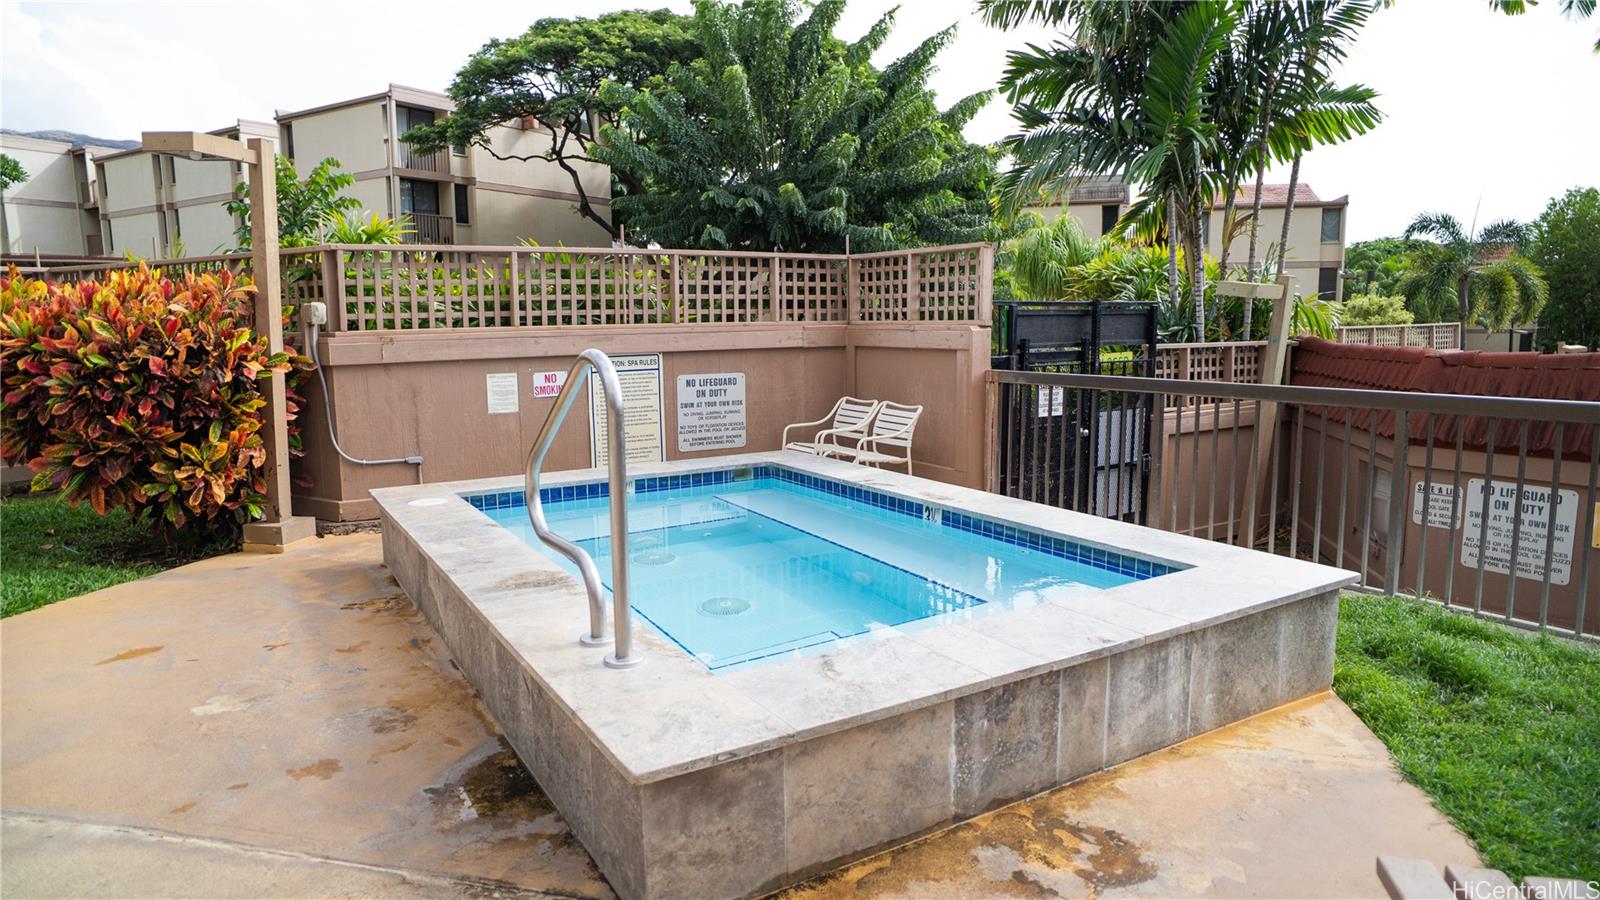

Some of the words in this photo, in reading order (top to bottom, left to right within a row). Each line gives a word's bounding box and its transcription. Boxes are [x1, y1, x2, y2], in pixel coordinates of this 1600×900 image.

[640, 358, 658, 366] RULES
[544, 373, 557, 383] NO
[685, 378, 697, 388] NO
[698, 377, 738, 388] LIFEGUARD
[534, 384, 564, 396] SMOKIN
[696, 389, 706, 398] ON
[708, 388, 728, 398] DUTY
[1438, 486, 1443, 494] A
[1500, 487, 1563, 505] LIFGUARD
[1494, 499, 1509, 511] ON
[1519, 502, 1544, 516] UTY
[1492, 514, 1502, 522] AT
[1528, 519, 1547, 529] OWN
[1552, 522, 1570, 533] ISK
